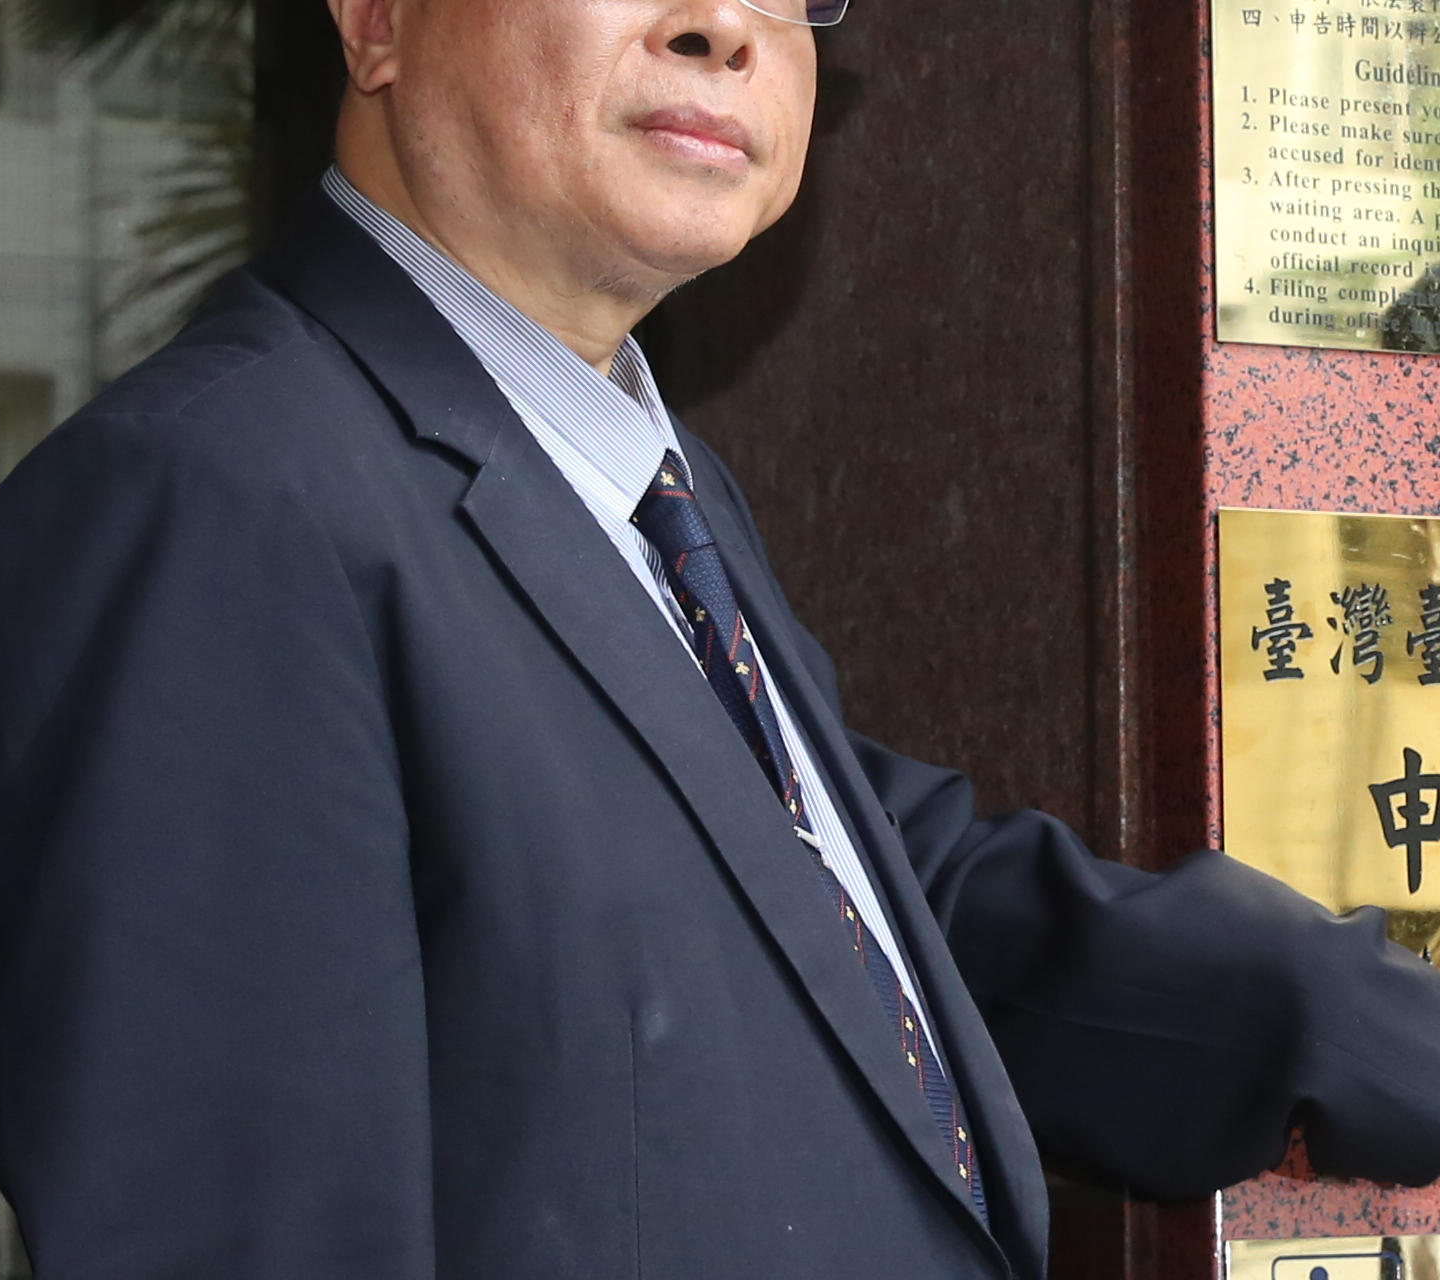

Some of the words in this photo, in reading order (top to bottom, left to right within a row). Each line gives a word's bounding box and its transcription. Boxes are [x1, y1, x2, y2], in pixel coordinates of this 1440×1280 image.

[1241, 86, 1257, 103] 1.
[1269, 87, 1330, 109] Please
[1340, 98, 1410, 119] present
[1241, 113, 1257, 131] 2.
[1269, 115, 1330, 137] Please
[1341, 123, 1392, 142] make
[1268, 147, 1344, 166] accused
[1356, 149, 1384, 168] for
[1242, 167, 1258, 186] 3.
[1269, 170, 1321, 190] After
[1332, 177, 1412, 201] pressing
[1270, 201, 1343, 223] waiting
[1353, 209, 1400, 223] area.
[1411, 212, 1426, 226] A
[1270, 225, 1347, 246] conduct
[1359, 234, 1381, 249] an
[1270, 253, 1340, 274] official
[1350, 257, 1414, 278] record
[1244, 278, 1260, 295] 4.
[1269, 278, 1328, 304] Filing
[1268, 306, 1335, 330] during
[1346, 312, 1401, 333] office
